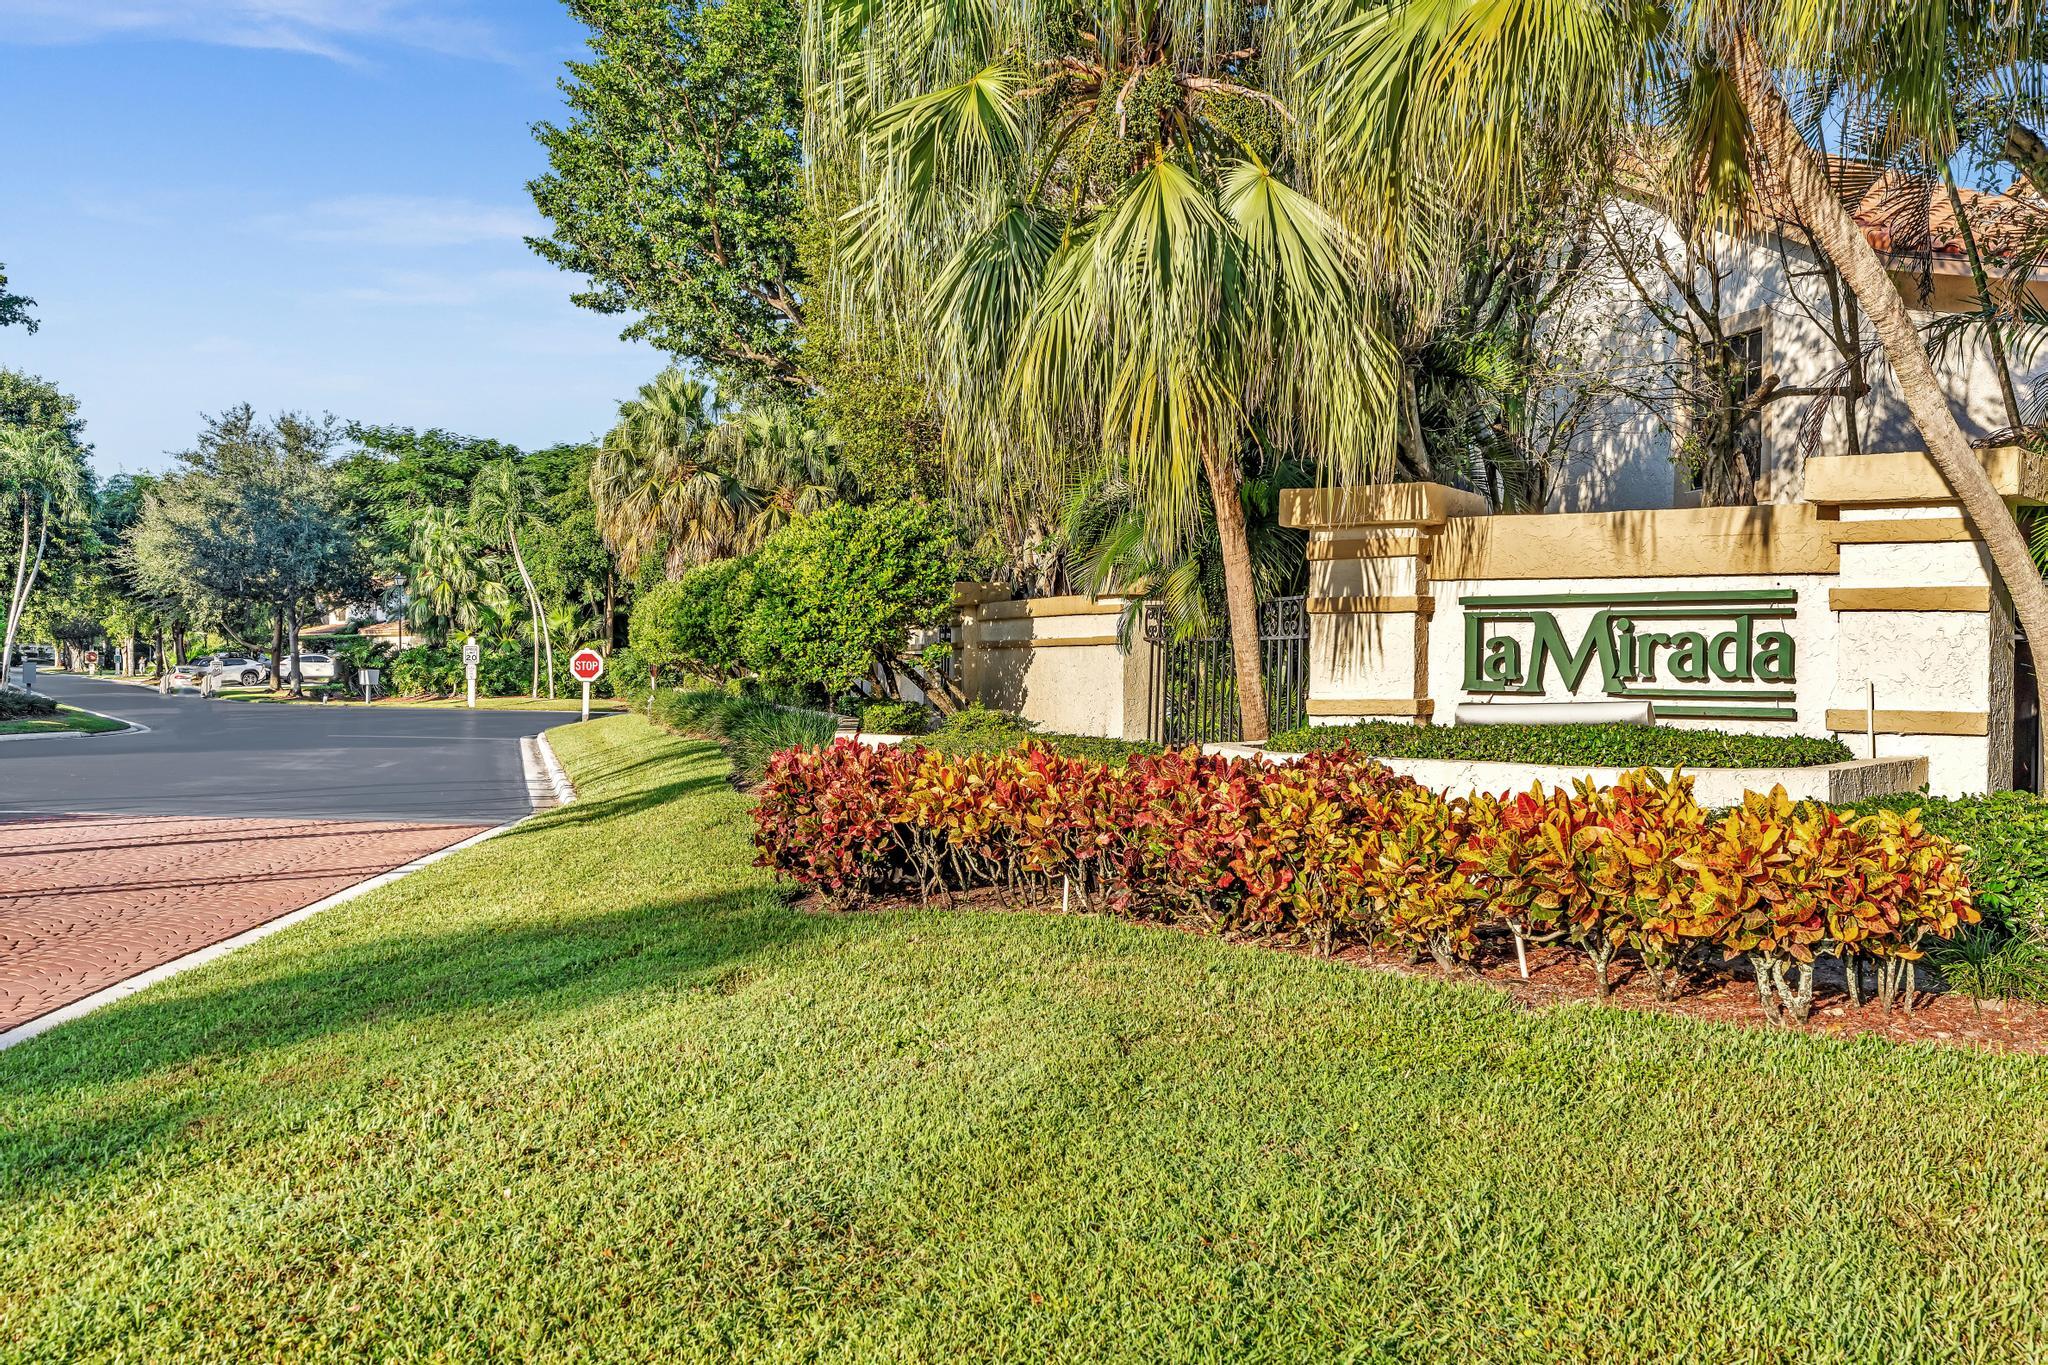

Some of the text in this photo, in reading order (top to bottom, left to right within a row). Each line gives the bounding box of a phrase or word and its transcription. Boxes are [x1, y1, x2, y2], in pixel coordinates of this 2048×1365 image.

[575, 660, 598, 671] STOP
[1461, 610, 1796, 693] La Mirada
